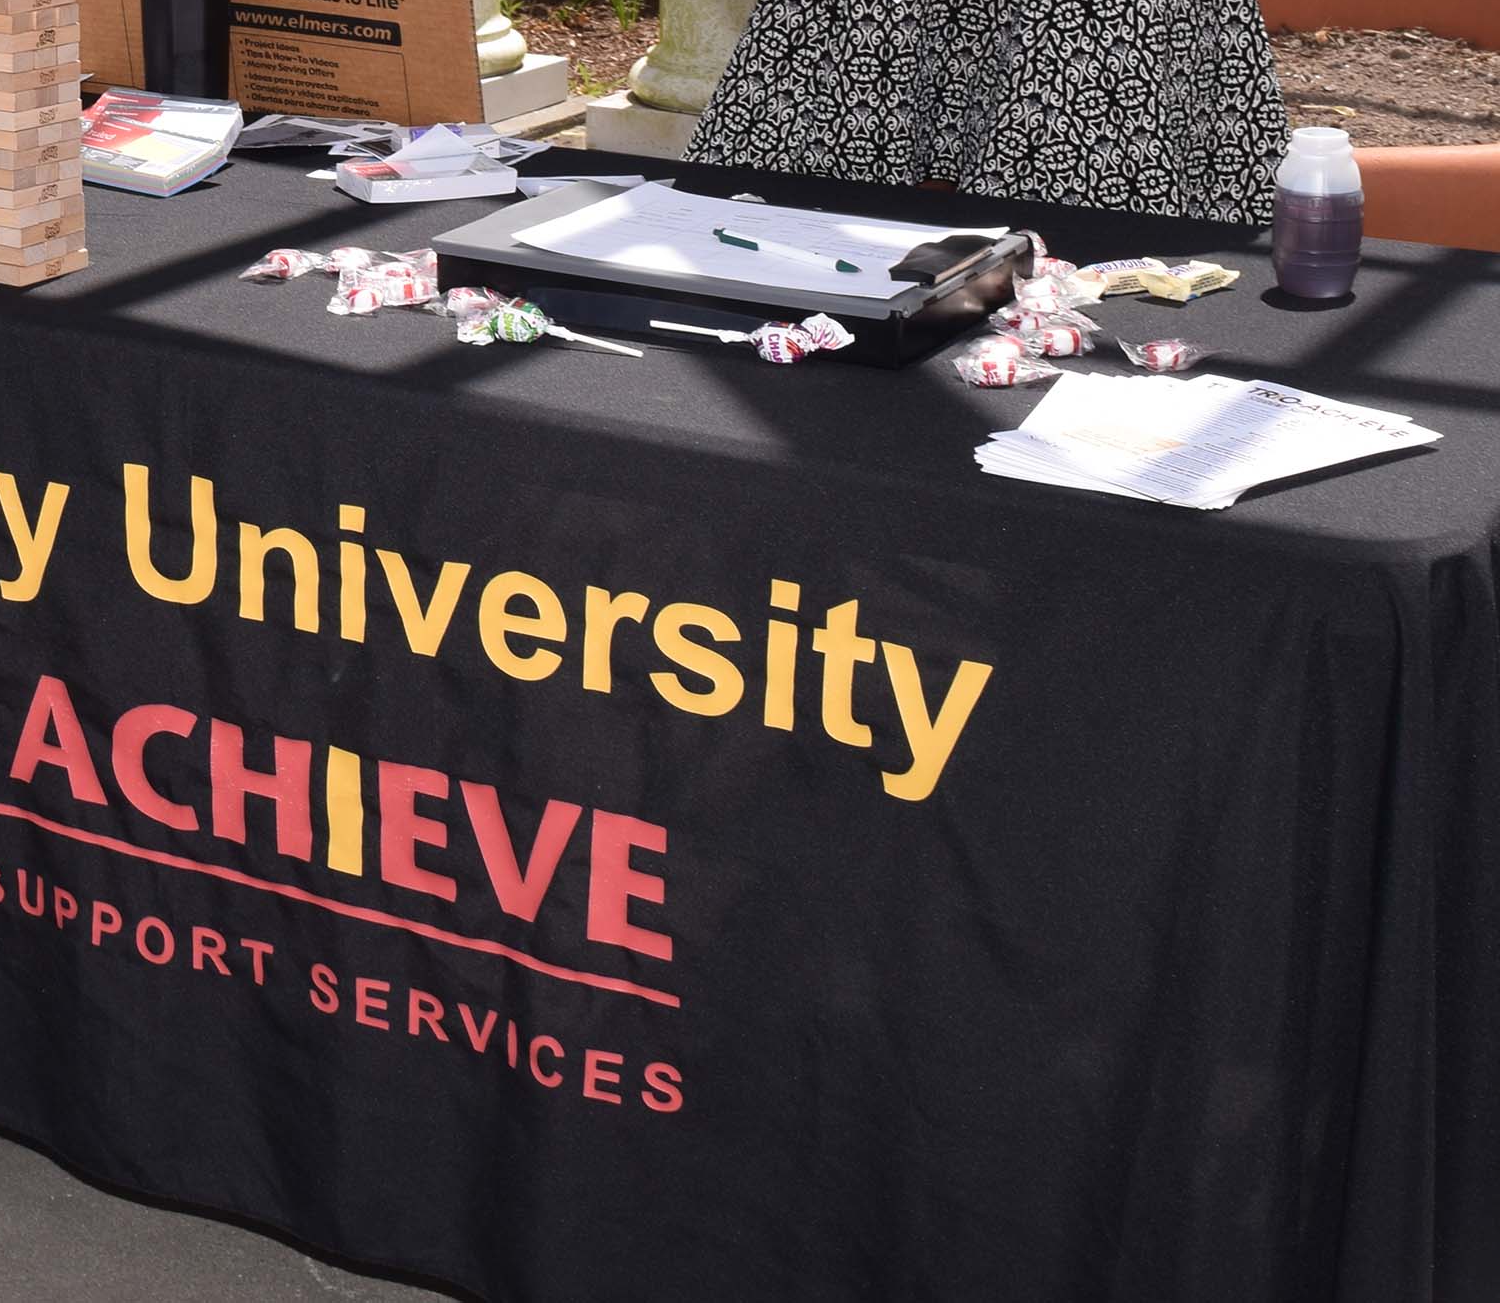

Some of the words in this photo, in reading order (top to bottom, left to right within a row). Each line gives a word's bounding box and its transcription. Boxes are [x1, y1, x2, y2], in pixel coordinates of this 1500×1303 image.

[235, 9, 392, 41] www.elmers.com
[123, 463, 993, 802] University
[9, 674, 674, 962] ACHIEVE
[309, 962, 684, 1113] SERVICES
